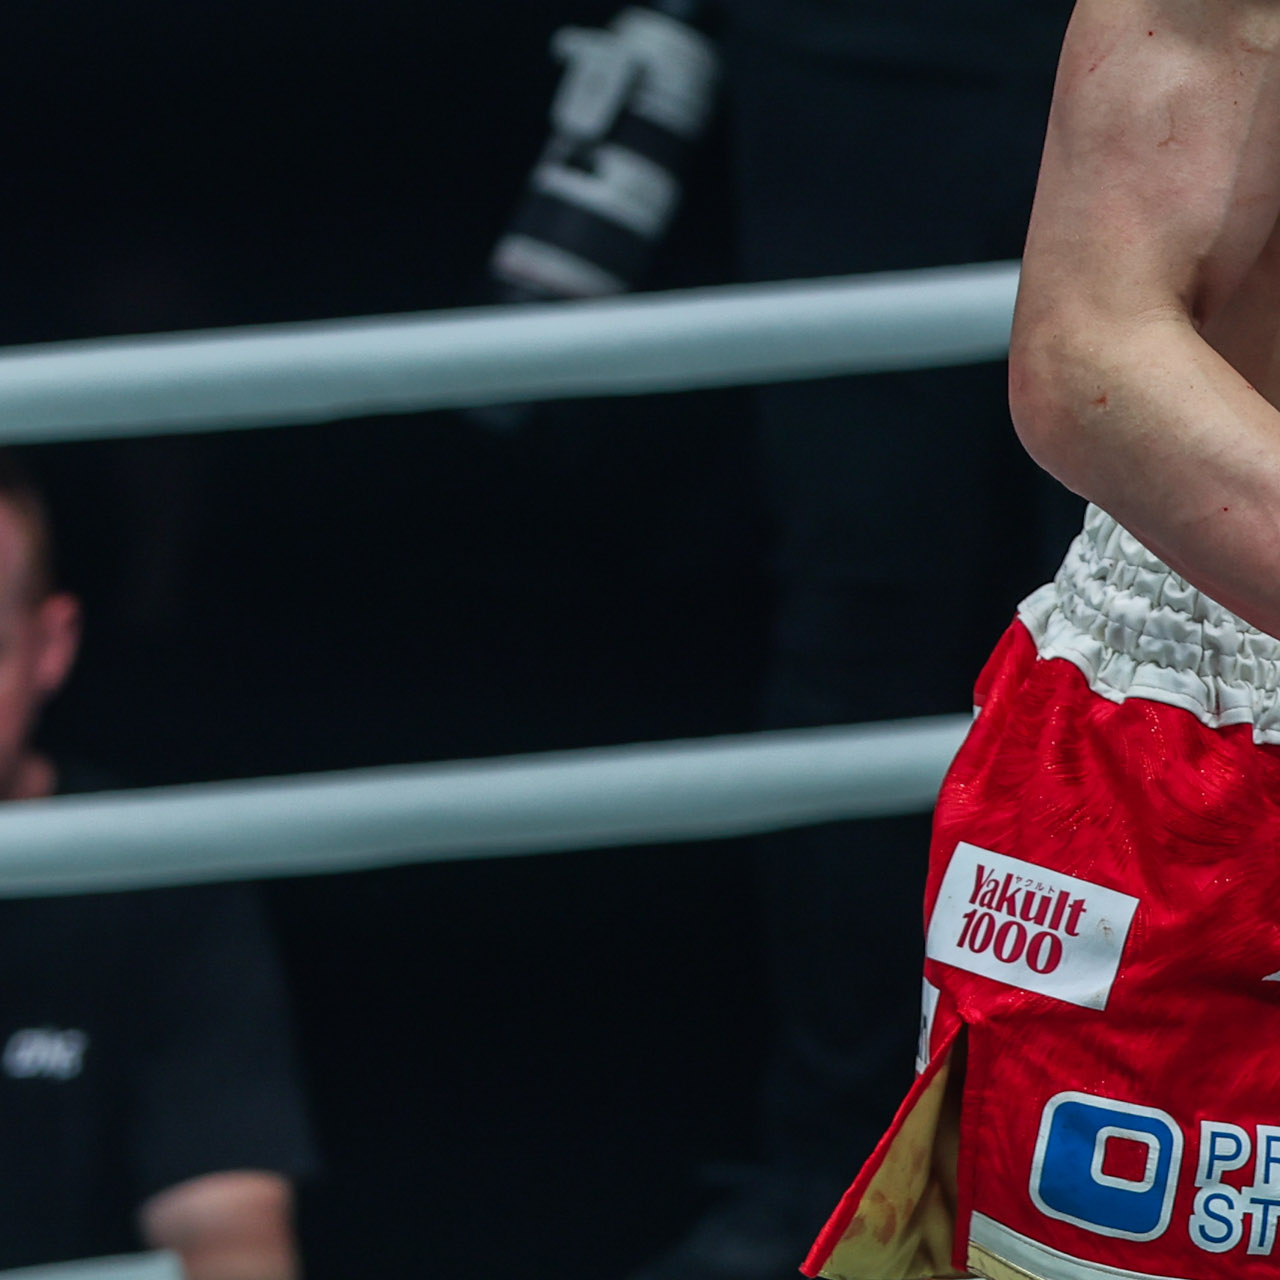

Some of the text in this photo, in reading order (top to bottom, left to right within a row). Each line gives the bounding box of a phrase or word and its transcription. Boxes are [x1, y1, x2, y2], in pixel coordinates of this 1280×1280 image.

[969, 863, 1087, 937] Yakult
[1015, 875, 1055, 894] ヤクルト
[956, 909, 1063, 975] 1000
